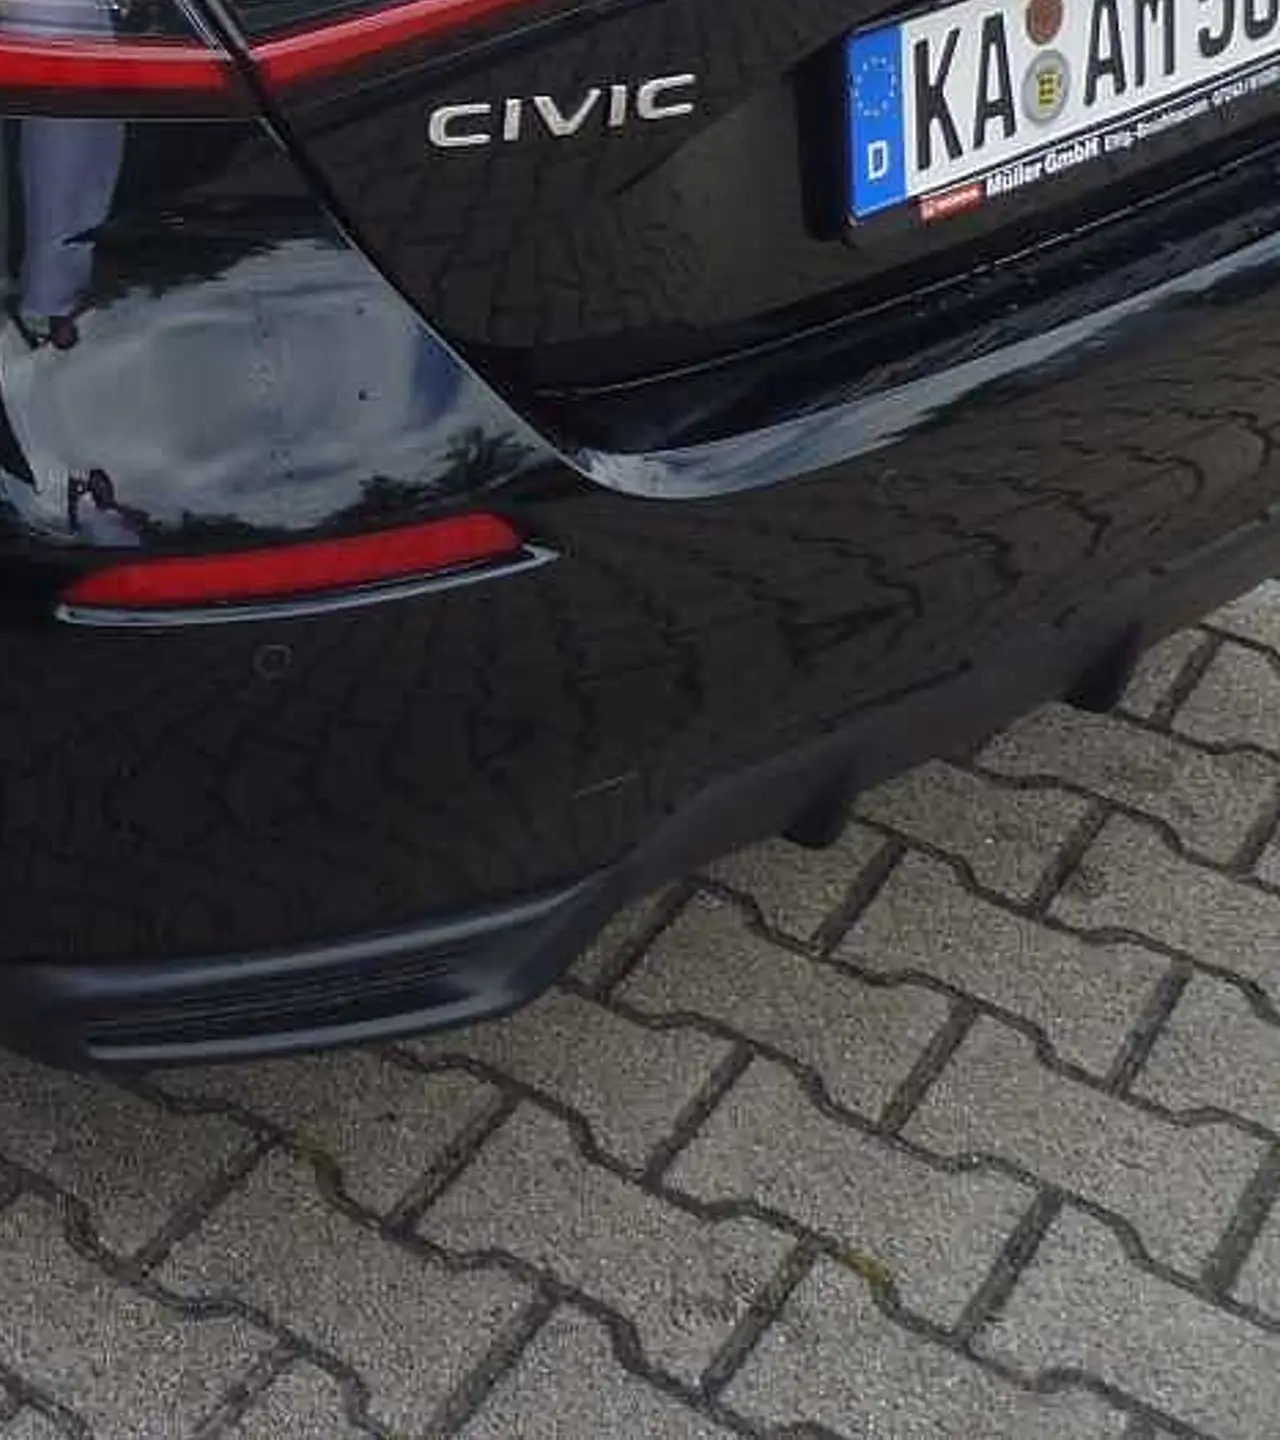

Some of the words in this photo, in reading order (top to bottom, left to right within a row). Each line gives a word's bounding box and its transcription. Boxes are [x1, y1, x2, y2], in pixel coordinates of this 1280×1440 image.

[429, 73, 695, 147] CIVIC
[913, 11, 1017, 171] KA
[985, 162, 1042, 198] Müller
[1044, 136, 1100, 174] GmbH
